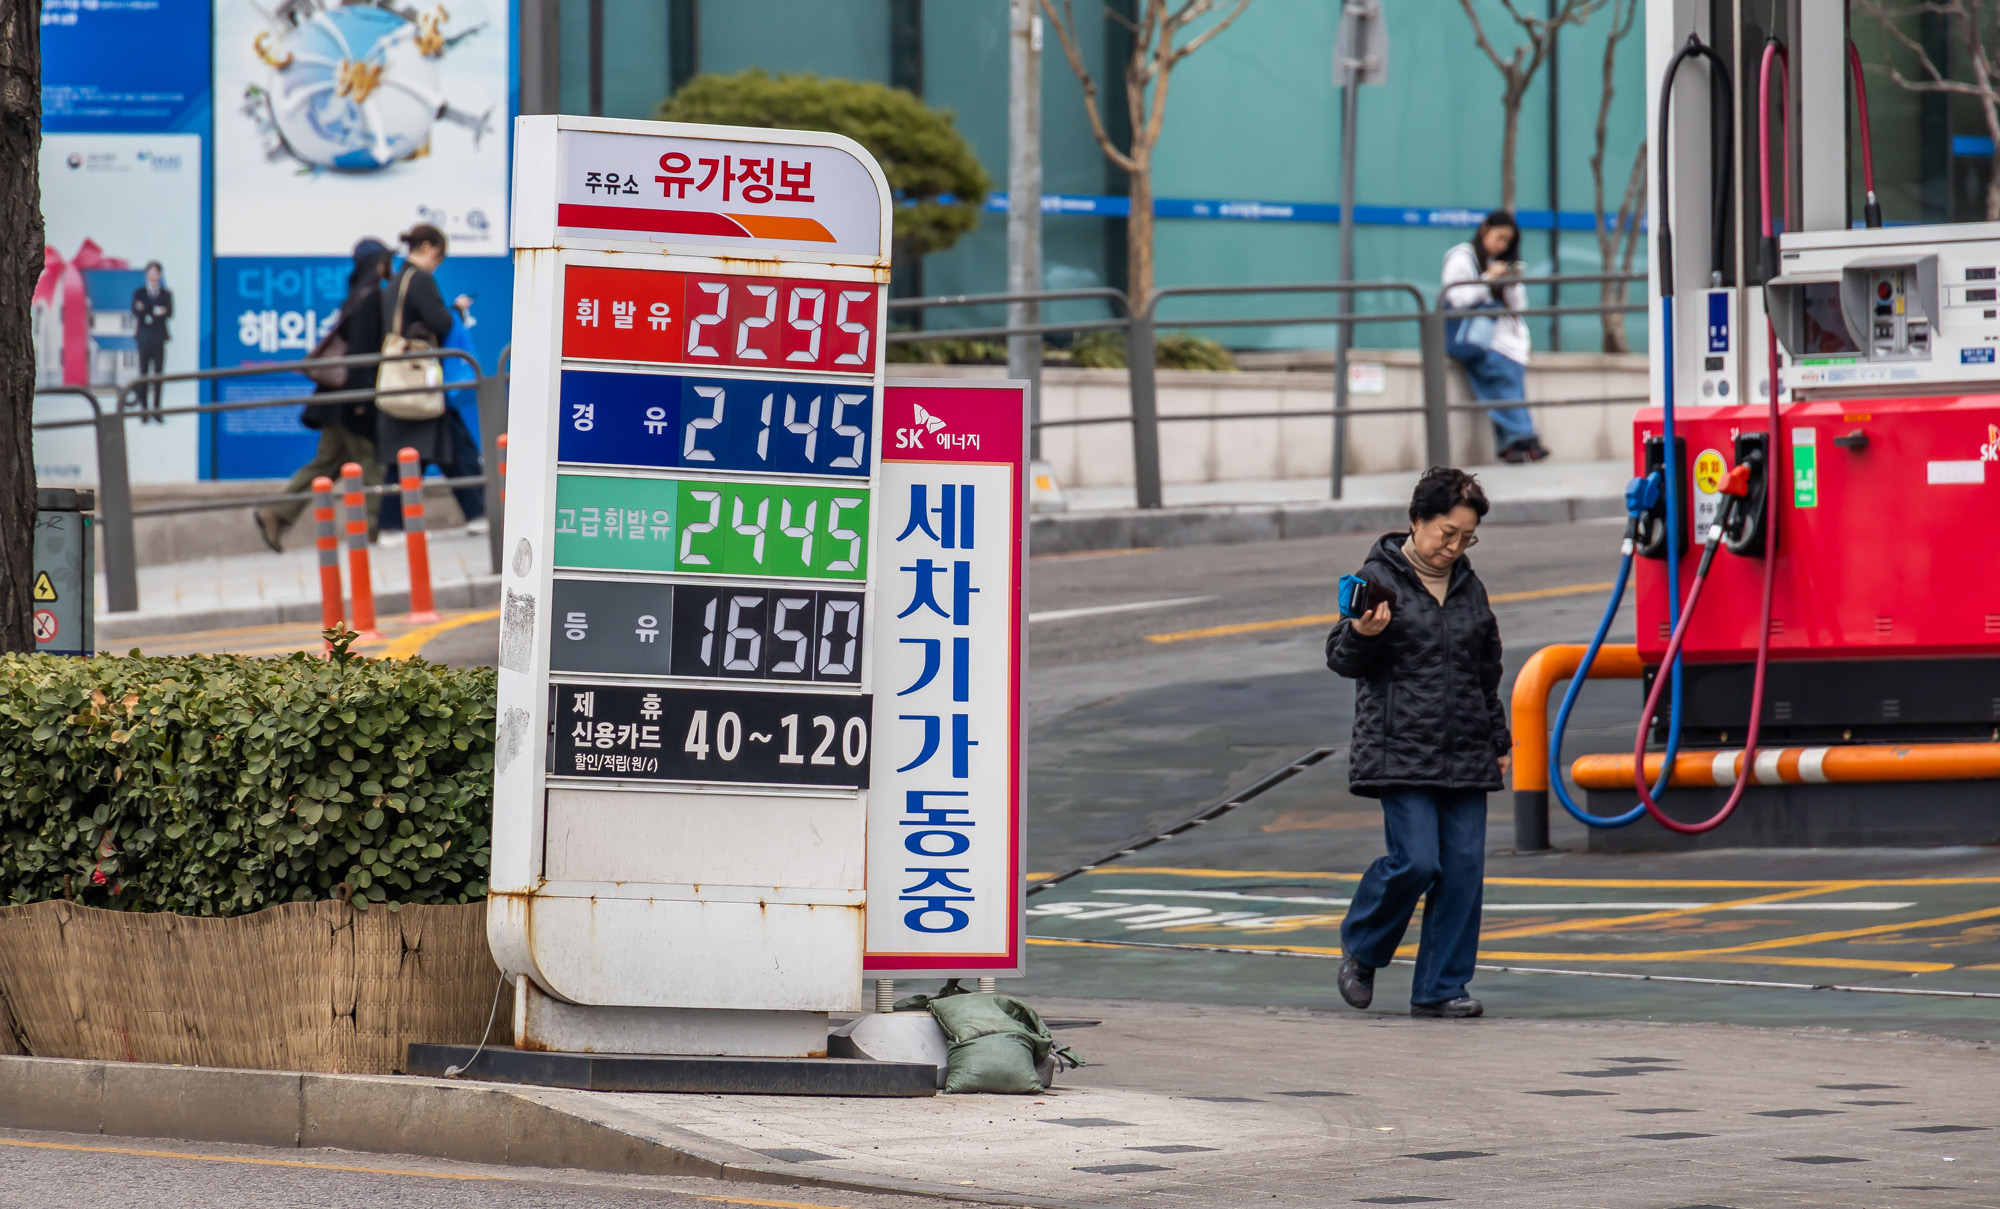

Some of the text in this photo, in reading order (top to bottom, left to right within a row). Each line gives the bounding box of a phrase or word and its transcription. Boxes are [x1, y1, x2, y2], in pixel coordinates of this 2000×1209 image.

[585, 151, 815, 204] 주유소 유가정보
[687, 281, 872, 366] 2295
[683, 385, 868, 469] 2145
[895, 427, 980, 450] SK 에너지
[1980, 443, 1999, 461] SK
[556, 506, 672, 540] 고급휘발유
[679, 489, 864, 572] 2445
[700, 595, 860, 675] 1650
[571, 721, 662, 750] 신용카드
[684, 709, 868, 767] 40~120
